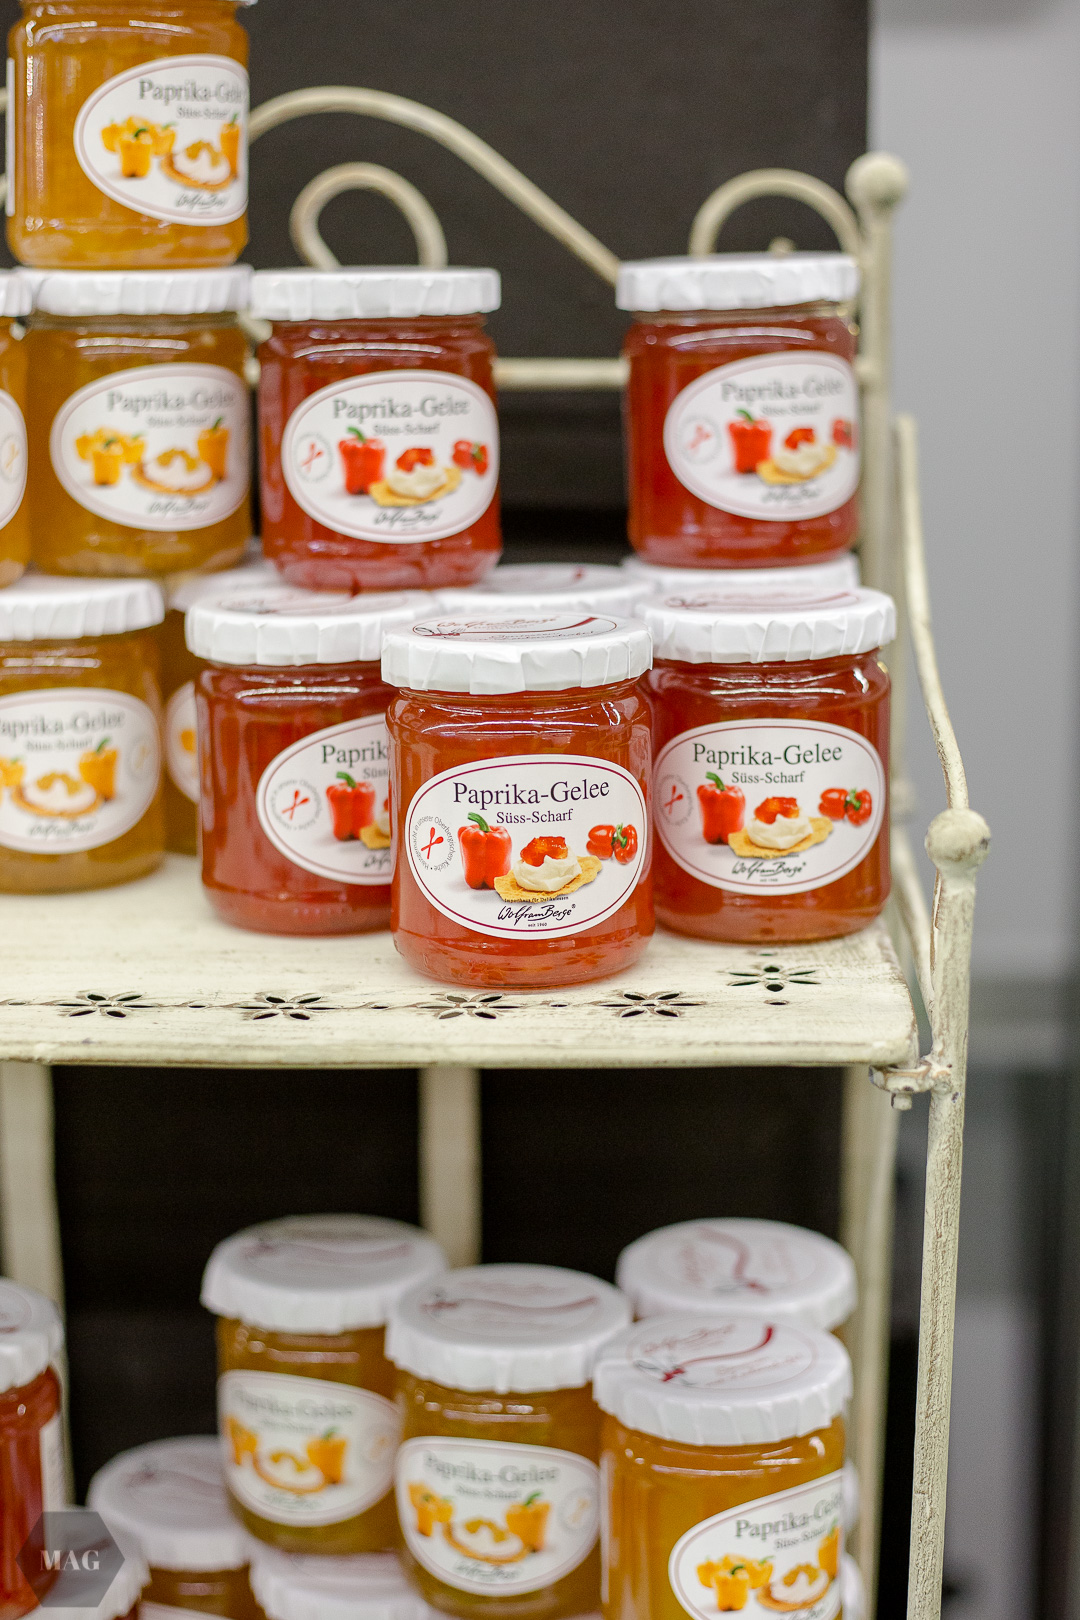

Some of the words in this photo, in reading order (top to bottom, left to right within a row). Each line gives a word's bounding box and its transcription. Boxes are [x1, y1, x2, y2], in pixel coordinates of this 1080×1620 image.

[333, 396, 471, 423] Paprika-Gelee
[0, 711, 125, 740] aprika-Gelee
[692, 742, 843, 769] Paprika-Gelee
[731, 771, 806, 784] Süss-Scharf
[453, 779, 610, 811] Paprika-Gelee
[496, 808, 574, 824] Süss-Scharf
